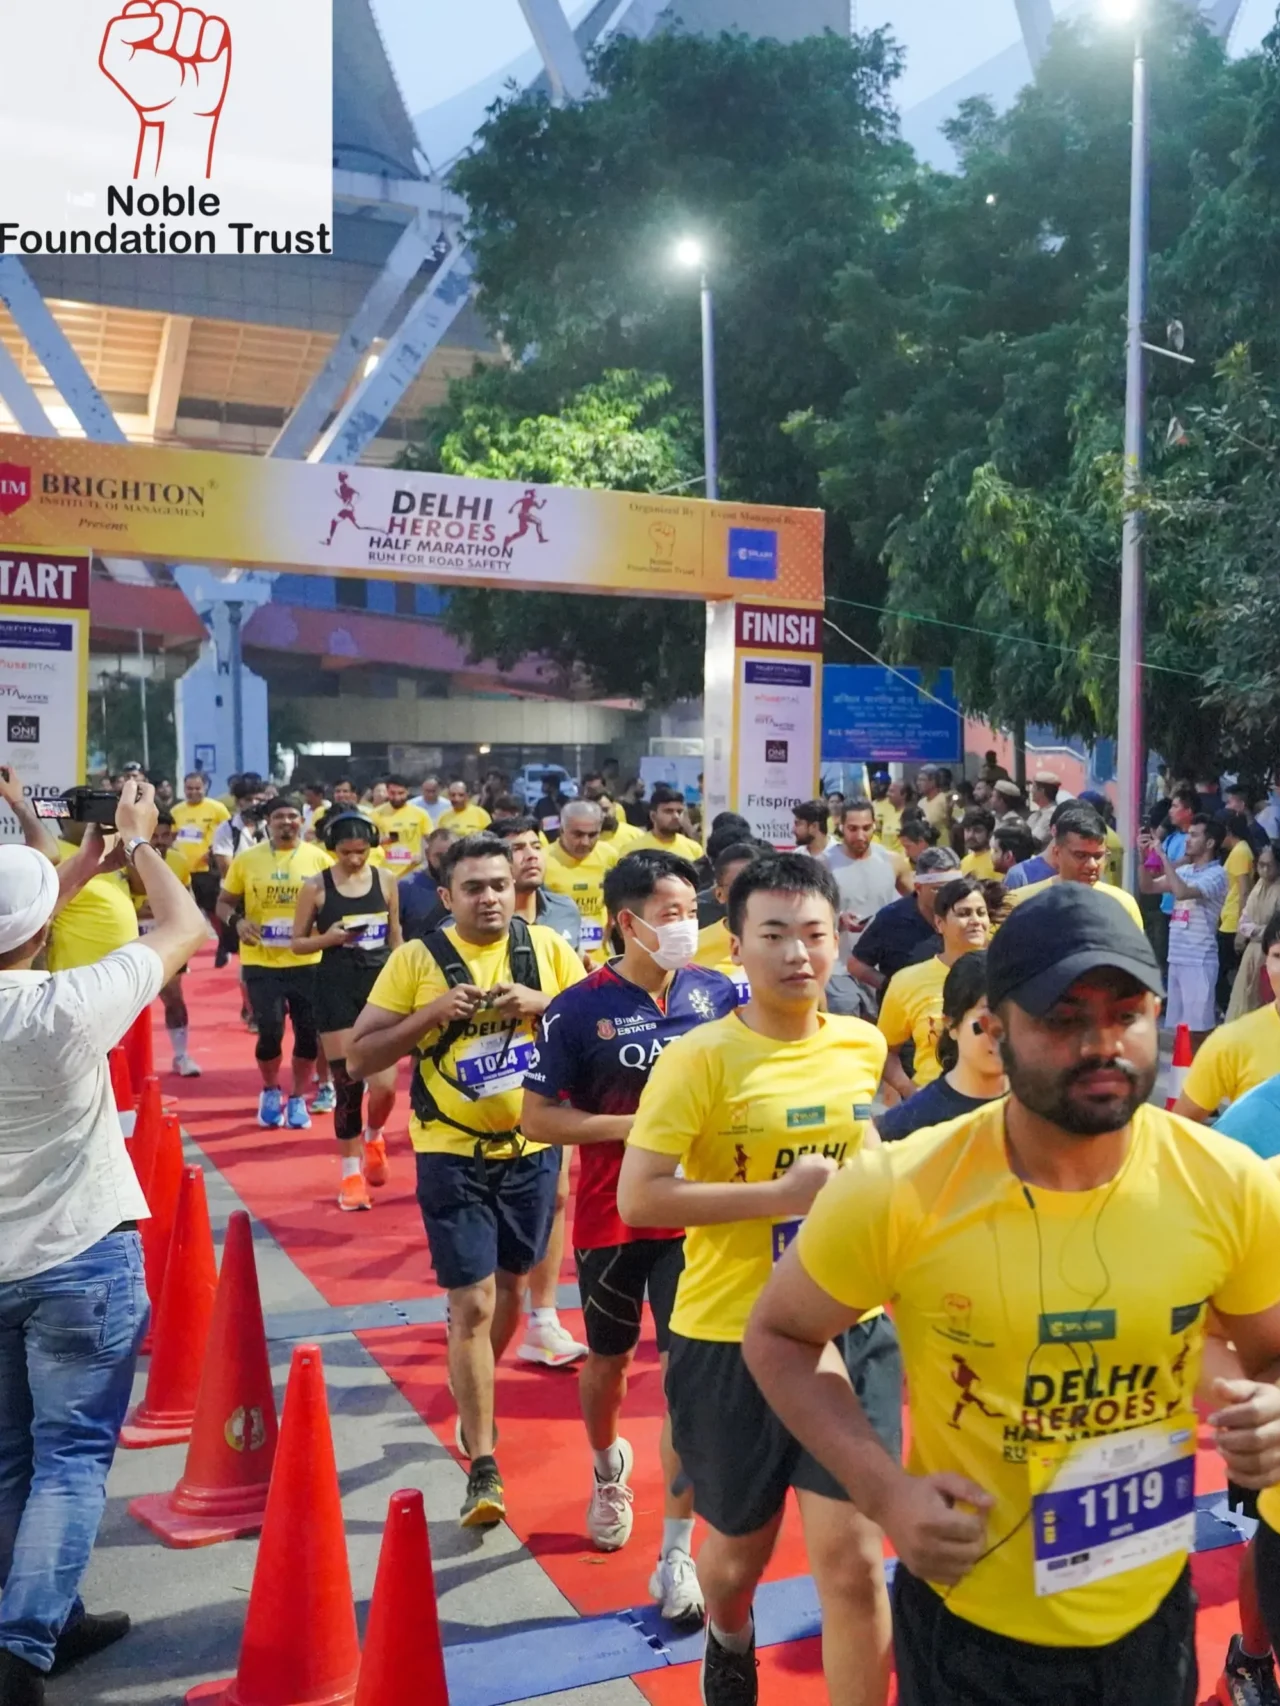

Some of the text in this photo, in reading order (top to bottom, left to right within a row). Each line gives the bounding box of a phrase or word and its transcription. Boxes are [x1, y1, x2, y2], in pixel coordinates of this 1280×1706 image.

[41, 473, 205, 506] BRIGHTON
[40, 496, 205, 518] INSTITUTE OF MANAGEMENT
[392, 490, 493, 521] DELHI
[78, 517, 128, 532] Presents
[388, 516, 496, 542] HEROES
[368, 536, 514, 559] HALF MARATHON
[368, 551, 511, 571] RUN FOR ROAD SAFETY
[742, 611, 816, 645] FINISH
[11, 726, 37, 736] ONE
[747, 794, 802, 809] Fitspire
[614, 1015, 645, 1026] BIRLA
[617, 1022, 657, 1036] ESTATES
[1023, 1364, 1159, 1407] DELHI
[1021, 1390, 1157, 1433] HEROES
[1078, 1471, 1164, 1527] 1119
